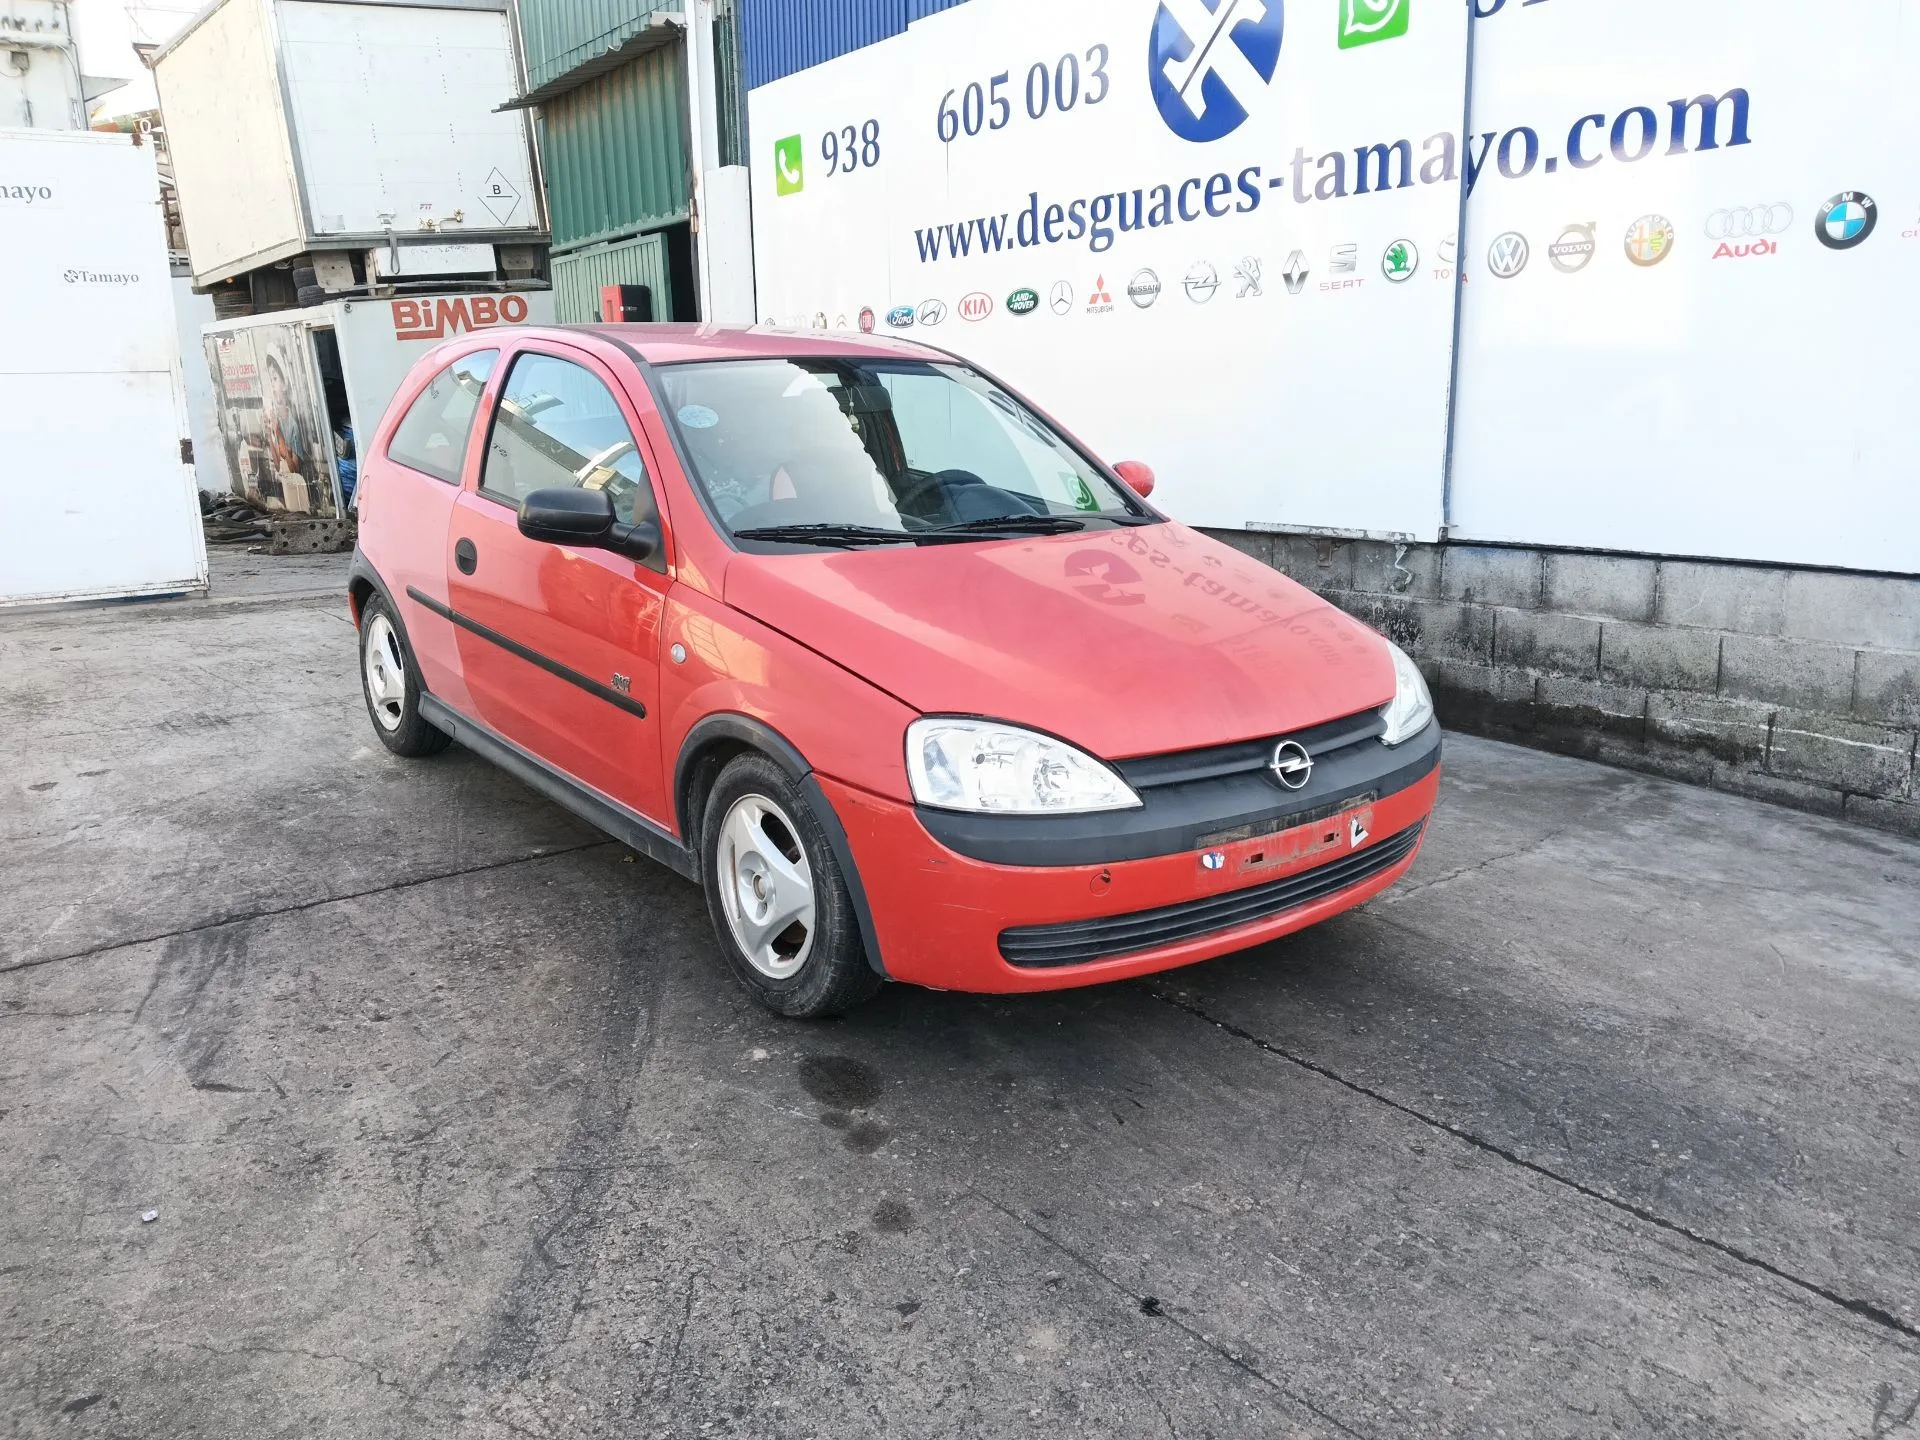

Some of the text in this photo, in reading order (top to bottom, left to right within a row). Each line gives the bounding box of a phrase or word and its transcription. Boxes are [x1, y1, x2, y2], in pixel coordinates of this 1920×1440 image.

[822, 43, 1110, 178] 938 605 003
[914, 87, 1752, 264] www.desguaces-tamayo.com
[492, 184, 502, 195] B
[1551, 243, 1592, 254] VOLVO
[1711, 238, 1777, 260] Audi
[78, 270, 140, 286] Tamayo
[1319, 278, 1365, 291] SEAT
[1130, 284, 1159, 294] NISSAN
[1012, 293, 1029, 302] LAND
[964, 298, 987, 316] KIA
[1012, 300, 1034, 311] ROVER
[1086, 305, 1114, 314] MITSUBISHI
[892, 308, 913, 325] Ford
